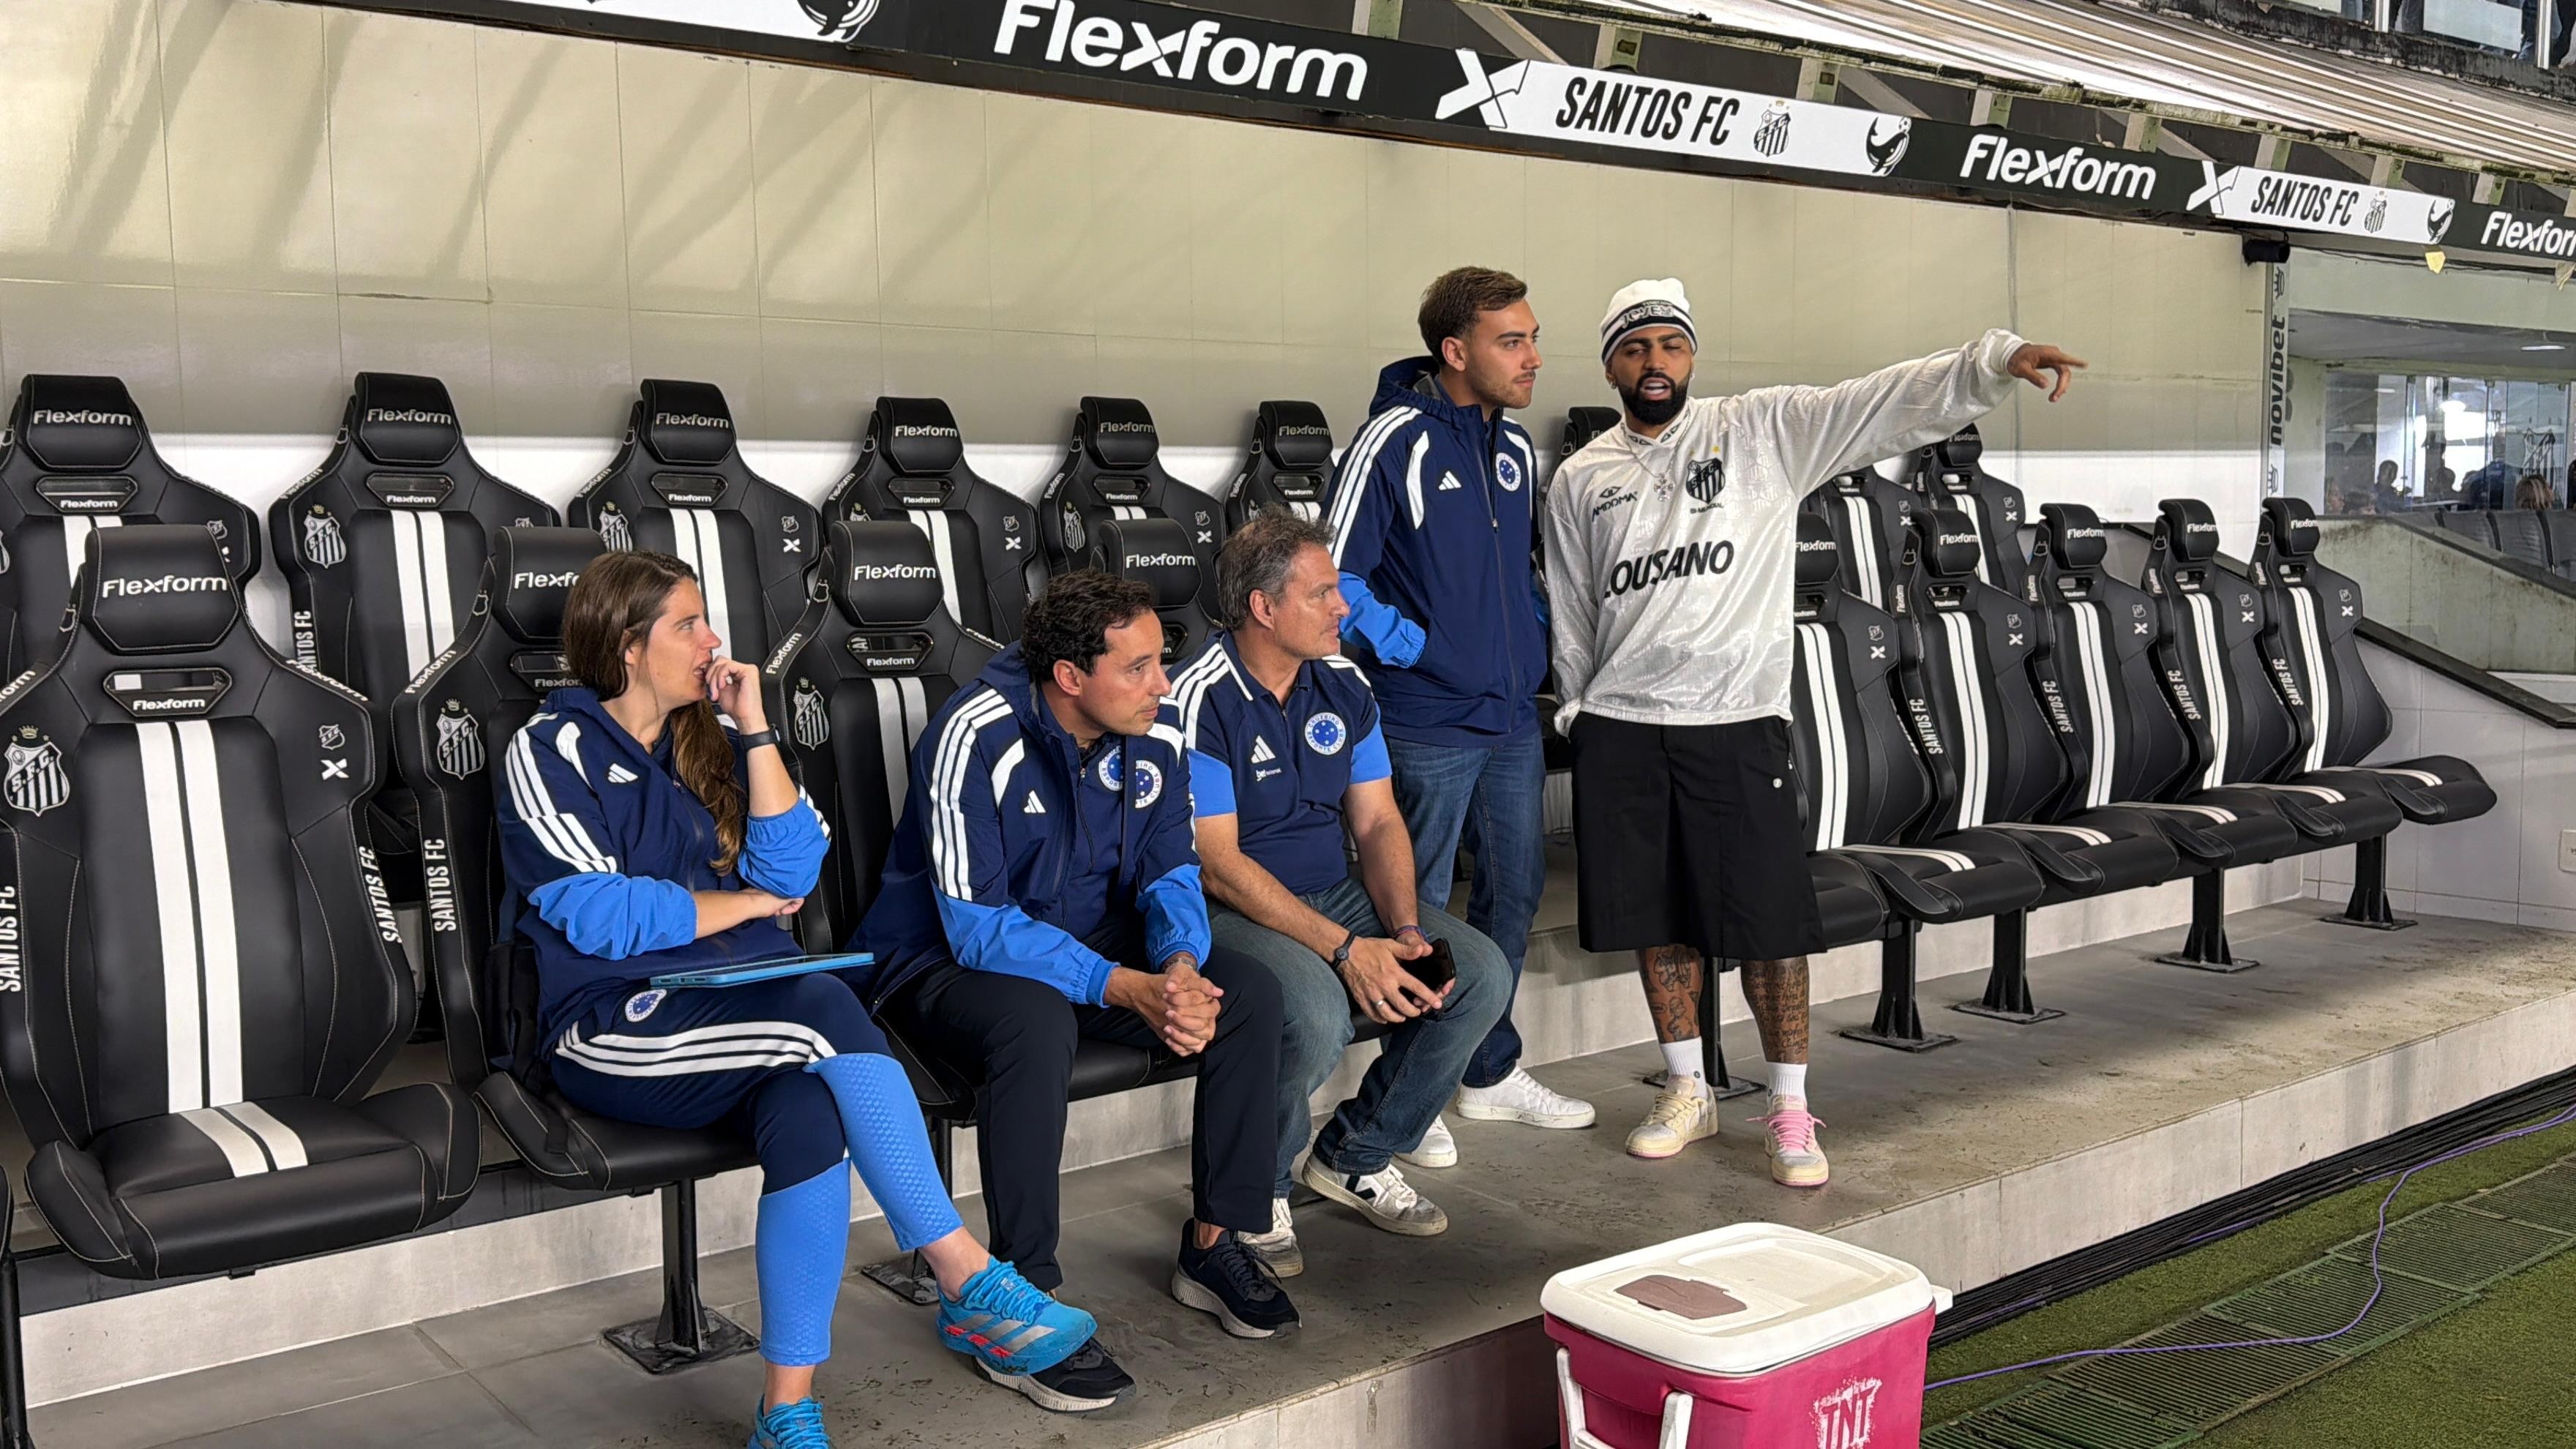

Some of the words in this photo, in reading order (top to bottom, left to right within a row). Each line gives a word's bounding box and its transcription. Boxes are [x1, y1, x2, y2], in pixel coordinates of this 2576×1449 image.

[994, 0, 1367, 100] Flexform
[1555, 76, 1692, 141] SANTOS
[1690, 95, 1740, 146] FC
[1959, 133, 2157, 200] Flexform
[2250, 176, 2332, 222] SANTOS
[2328, 189, 2359, 227] FC
[2271, 315, 2285, 446] novibet
[34, 409, 132, 426] Flexform
[367, 408, 452, 425] Flexform
[656, 412, 729, 429] Flexform
[895, 424, 958, 438] Flexform
[1100, 421, 1155, 433] Flexform
[1278, 425, 1330, 437] Flexform
[60, 499, 119, 509] Flexform
[386, 495, 436, 503] Flexform
[668, 493, 713, 503] Flexform
[902, 495, 940, 504] Flexform
[1126, 553, 1196, 569] Flexform
[514, 572, 580, 590] Flexf
[854, 564, 937, 580] Flexform
[101, 574, 228, 599] Flexform
[294, 610, 313, 628] FC
[295, 631, 318, 672] ANTOS
[765, 632, 803, 675] Flexform
[866, 657, 915, 667] Flexform
[405, 649, 457, 694] Flexform
[2168, 670, 2184, 682] FC
[534, 678, 583, 688] Flexfor
[2043, 680, 2059, 694] FC
[2278, 672, 2304, 706] SANTOS
[132, 698, 206, 711] Flexform
[1909, 698, 1927, 712] FC
[2174, 684, 2201, 720] SANTOS
[2048, 695, 2074, 733] SANTOS
[1914, 714, 1944, 755] SANTOS
[359, 846, 380, 871] FC
[424, 839, 446, 860] FC
[427, 866, 457, 932] SANTOS
[366, 875, 402, 943] SANTOS
[1815, 1379, 1882, 1449] TNT
